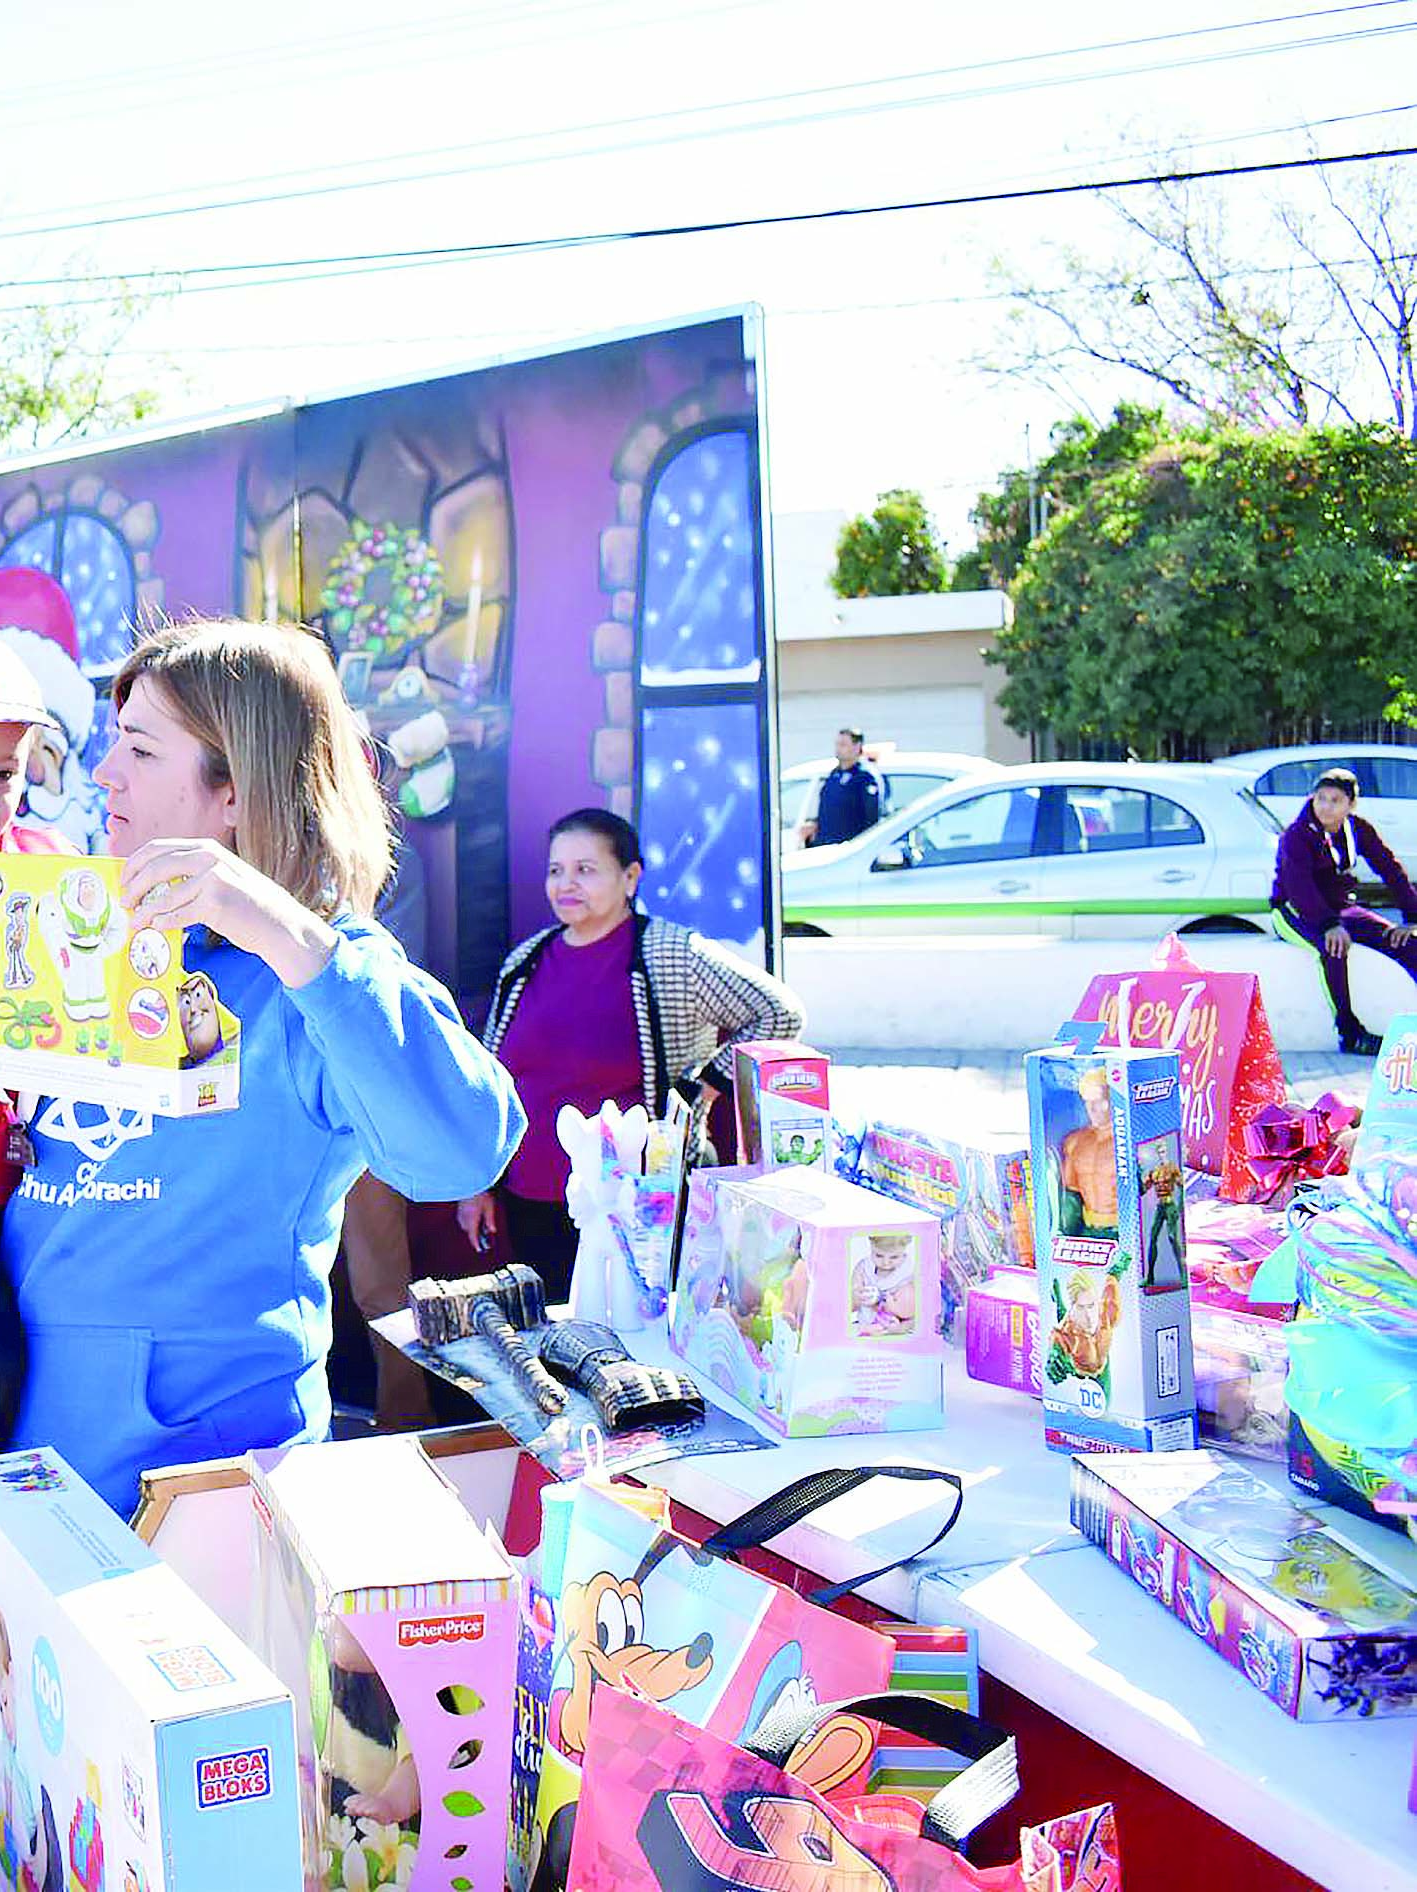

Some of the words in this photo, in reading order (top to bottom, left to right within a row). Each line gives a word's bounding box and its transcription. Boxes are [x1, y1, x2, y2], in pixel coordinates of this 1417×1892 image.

[1113, 1106, 1128, 1177] AQUAMAN
[1080, 1388, 1102, 1410] DC
[402, 1620, 480, 1639] Fisher-Price
[34, 1652, 62, 1721] 100
[202, 1754, 264, 1780] MEGA
[204, 1774, 266, 1801] BLOKS
